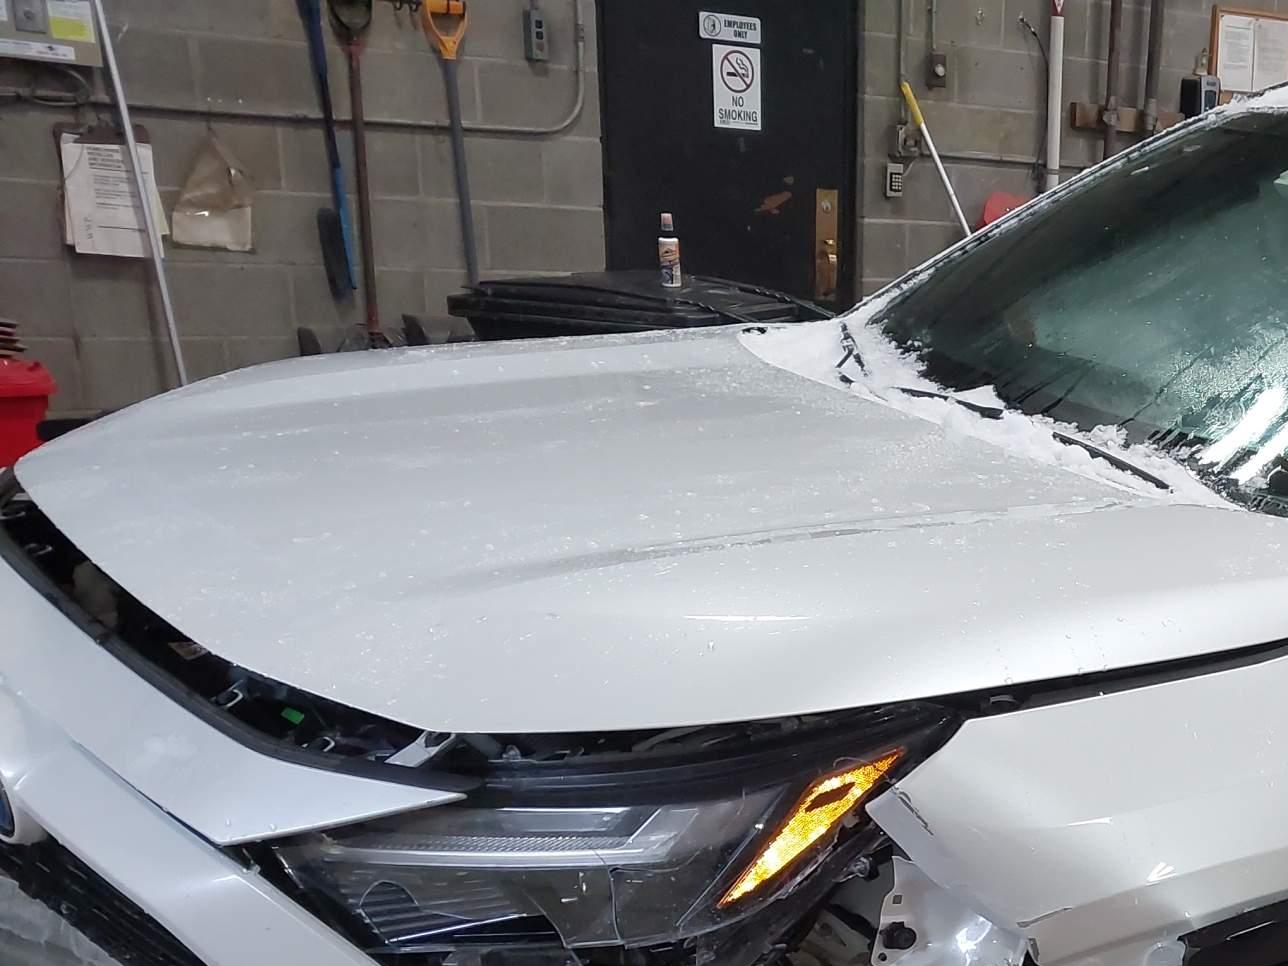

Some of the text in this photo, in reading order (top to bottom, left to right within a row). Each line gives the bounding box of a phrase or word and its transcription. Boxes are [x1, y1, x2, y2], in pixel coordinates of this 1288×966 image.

[724, 19, 757, 31] EMPLOYEES
[733, 30, 748, 39] ONLY
[731, 95, 745, 108] NO
[718, 108, 758, 122] SMOKING
